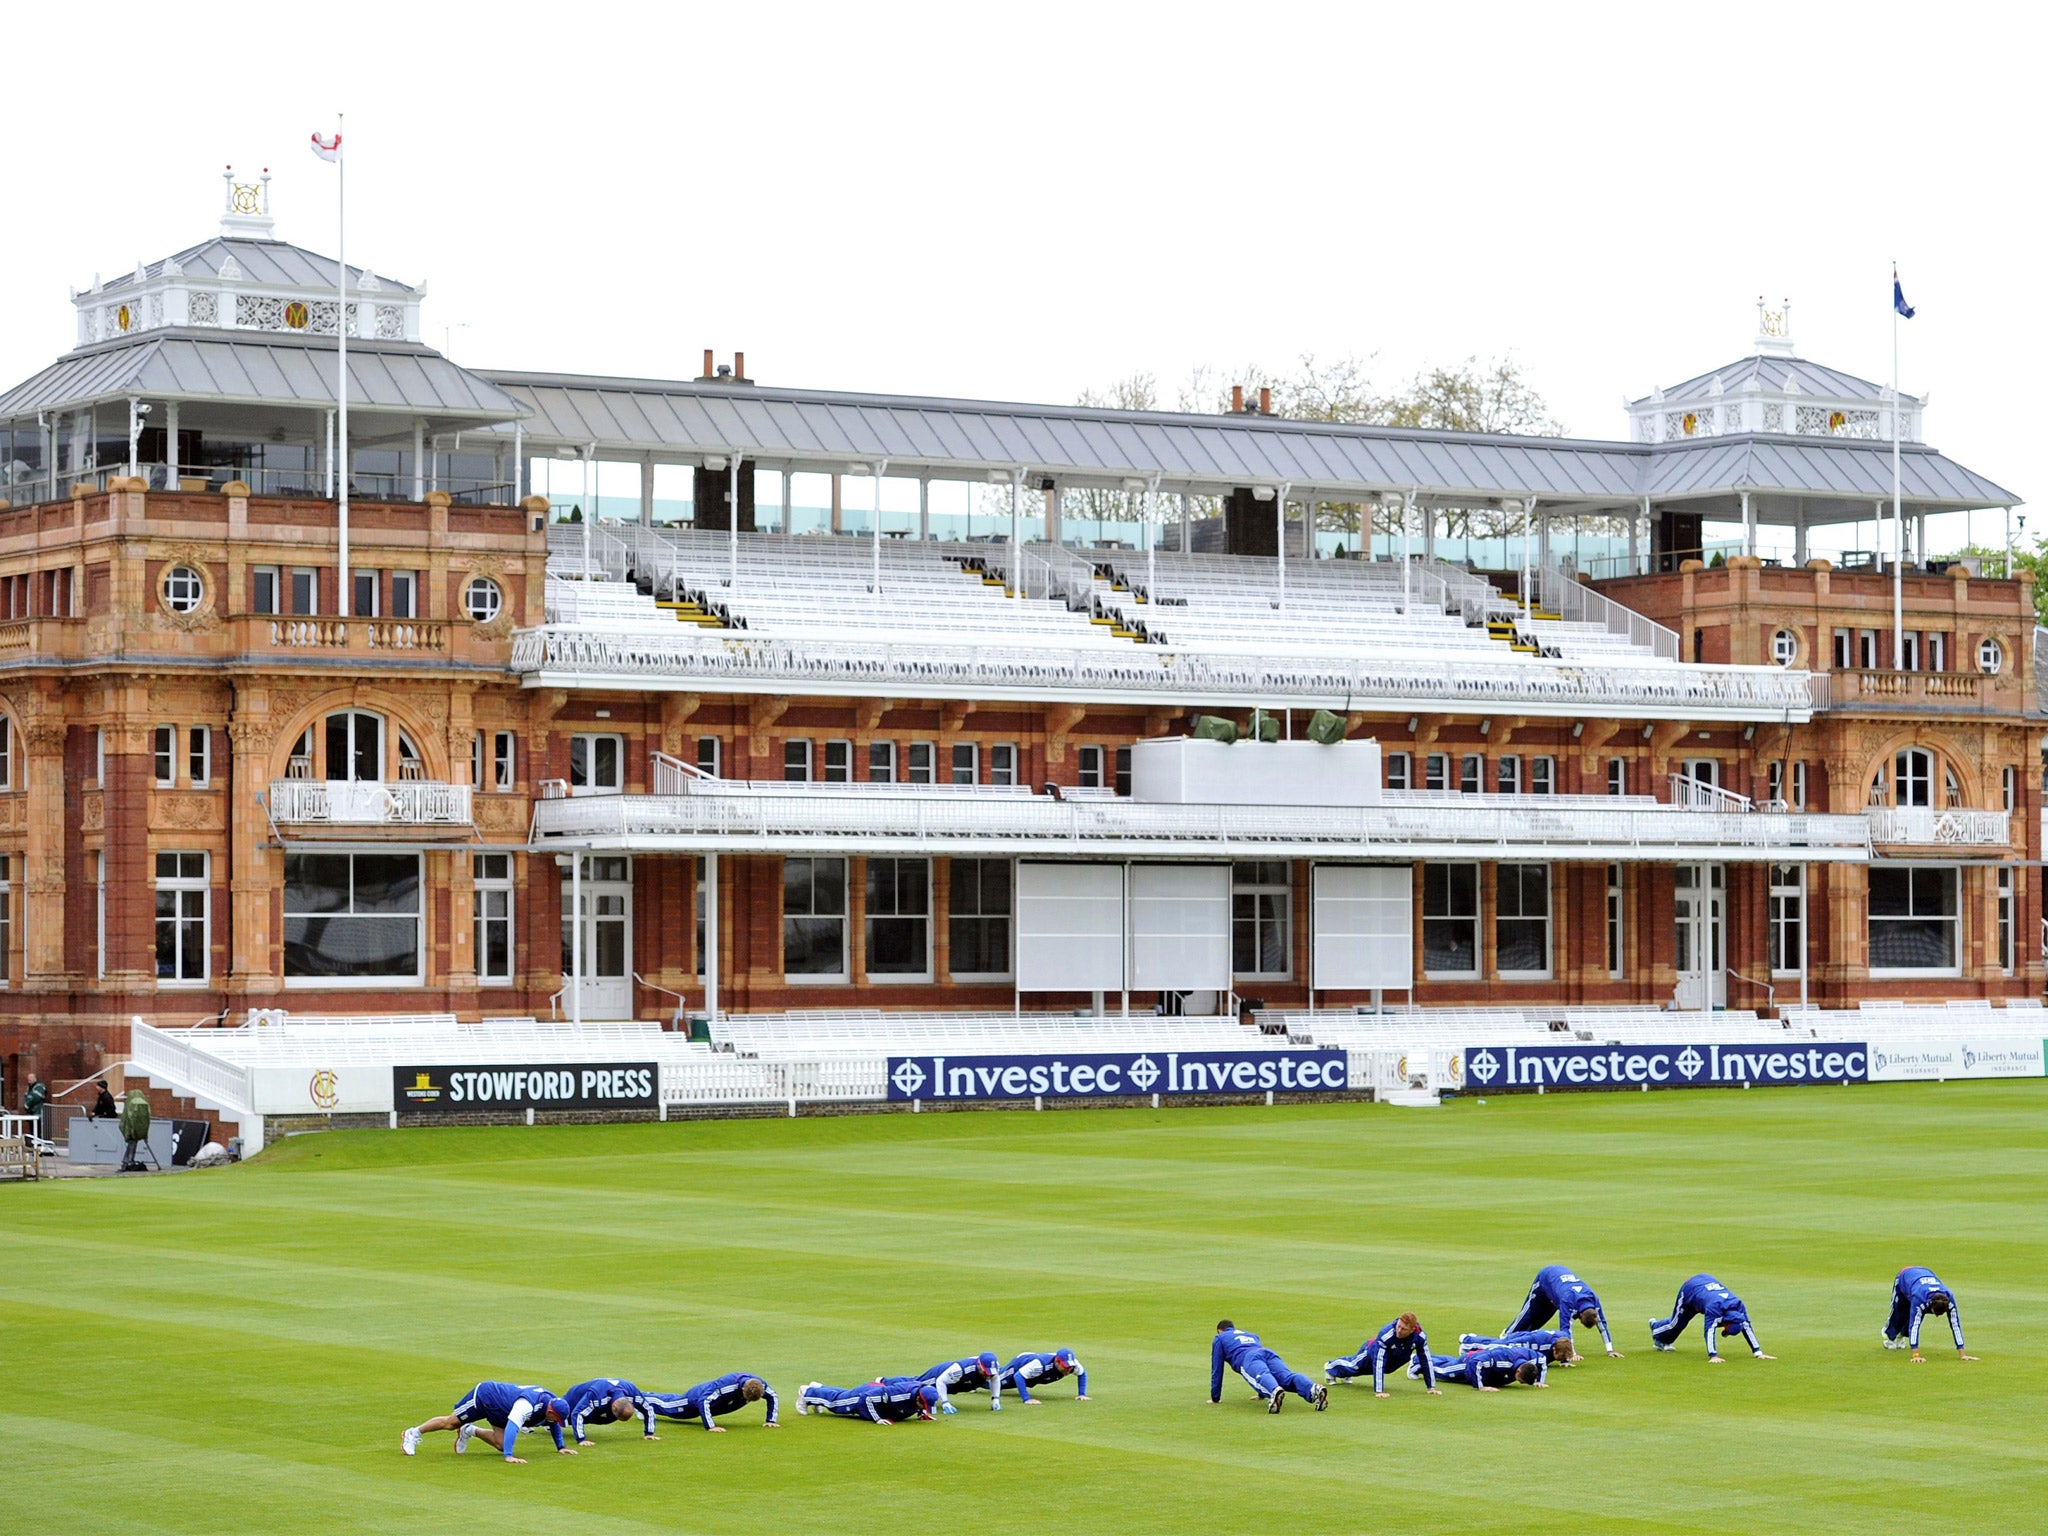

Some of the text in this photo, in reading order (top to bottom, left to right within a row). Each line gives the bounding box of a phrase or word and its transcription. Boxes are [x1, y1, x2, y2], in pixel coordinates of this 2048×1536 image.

[1505, 1047, 1670, 1086] Investec
[1709, 1045, 1865, 1083] Investec
[1889, 1052, 1952, 1064] Liberty Mutual
[1978, 1050, 2039, 1062] Liberty Mutual
[450, 1069, 652, 1102] STOWFORD PRESS
[933, 1053, 1345, 1096] Investec Investec
